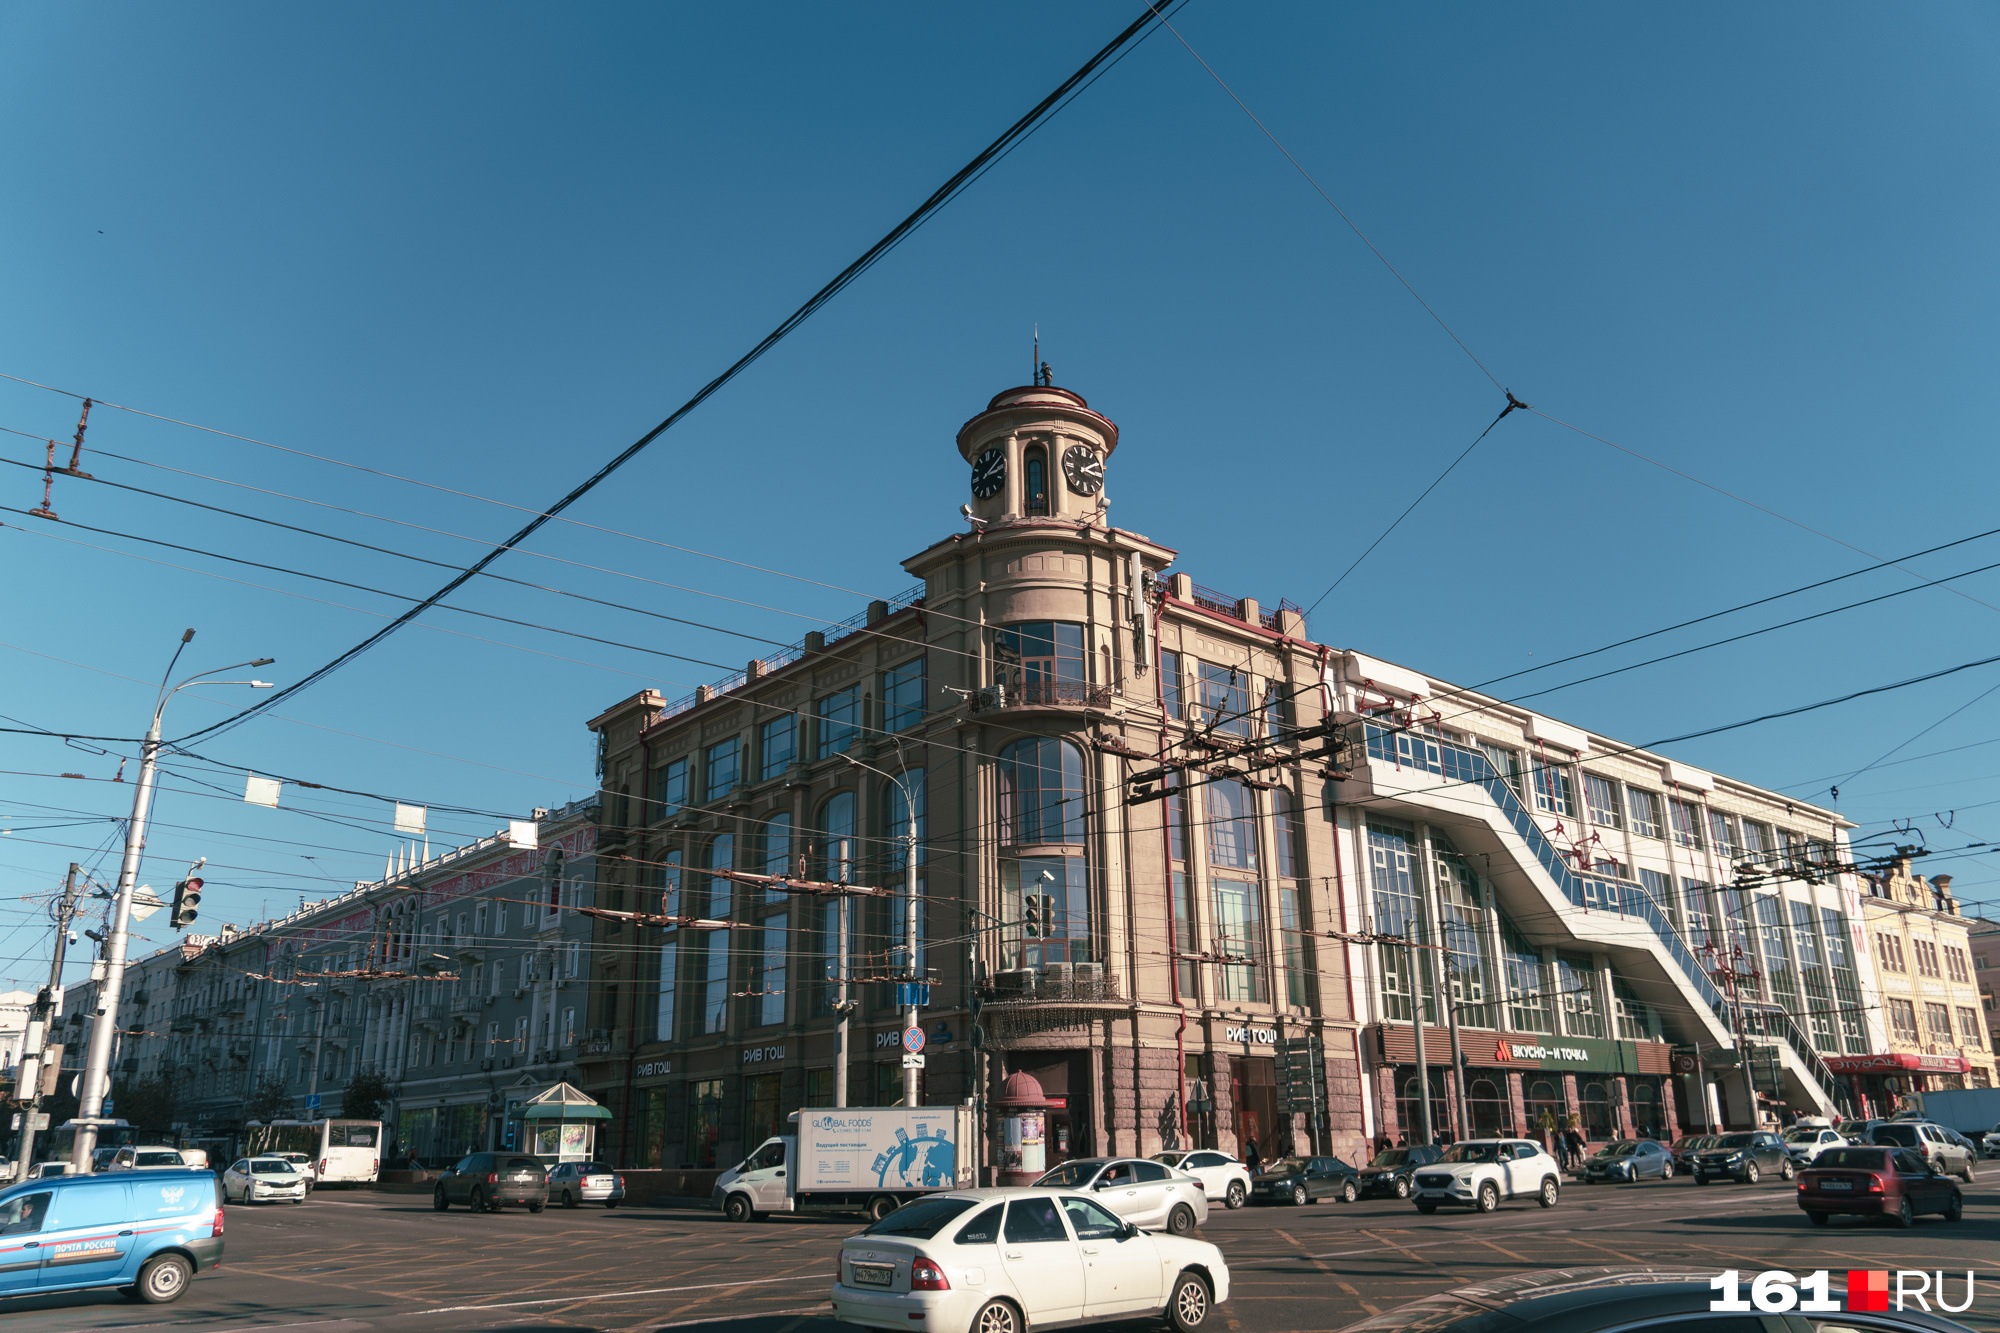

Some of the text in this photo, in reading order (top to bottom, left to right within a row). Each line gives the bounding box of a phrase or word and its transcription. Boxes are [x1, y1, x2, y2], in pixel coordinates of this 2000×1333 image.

[877, 1031, 899, 1048] РИВ
[1226, 1027, 1277, 1043] РИВ ГОШ
[743, 1045, 785, 1063] РИВ ГОШ
[1512, 1045, 1546, 1059] ВКУСНО
[1561, 1048, 1588, 1061] ТОЧКА
[637, 1061, 671, 1077] РИВ ГОШ
[812, 1116, 872, 1131] GLOBAL FOODS
[55, 1240, 116, 1253] ПОЧТА РОССИИ
